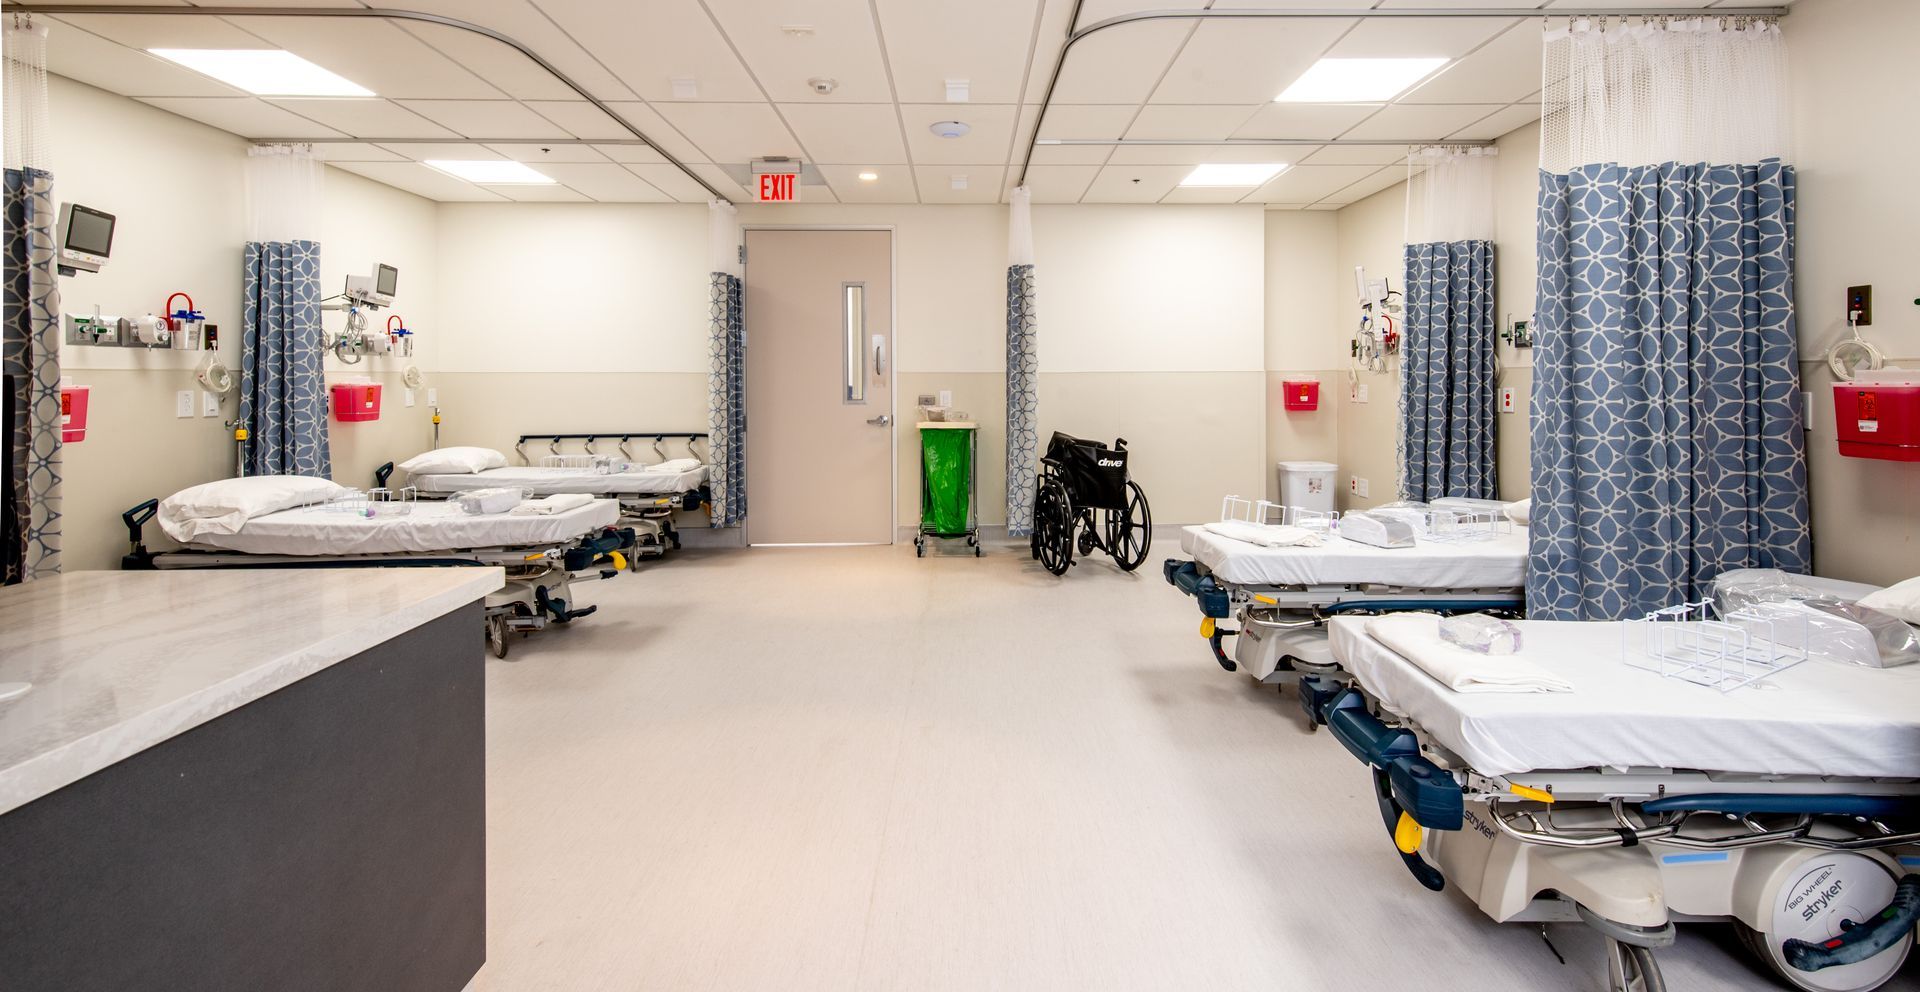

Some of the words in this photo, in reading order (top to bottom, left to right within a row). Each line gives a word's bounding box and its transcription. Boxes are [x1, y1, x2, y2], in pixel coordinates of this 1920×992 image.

[760, 174, 795, 200] EXIT
[1098, 458, 1123, 467] drive
[1464, 810, 1495, 839] stryker
[1788, 896, 1803, 909] BIG
[1803, 871, 1832, 896] WHEEL
[1802, 880, 1842, 921] stryker
